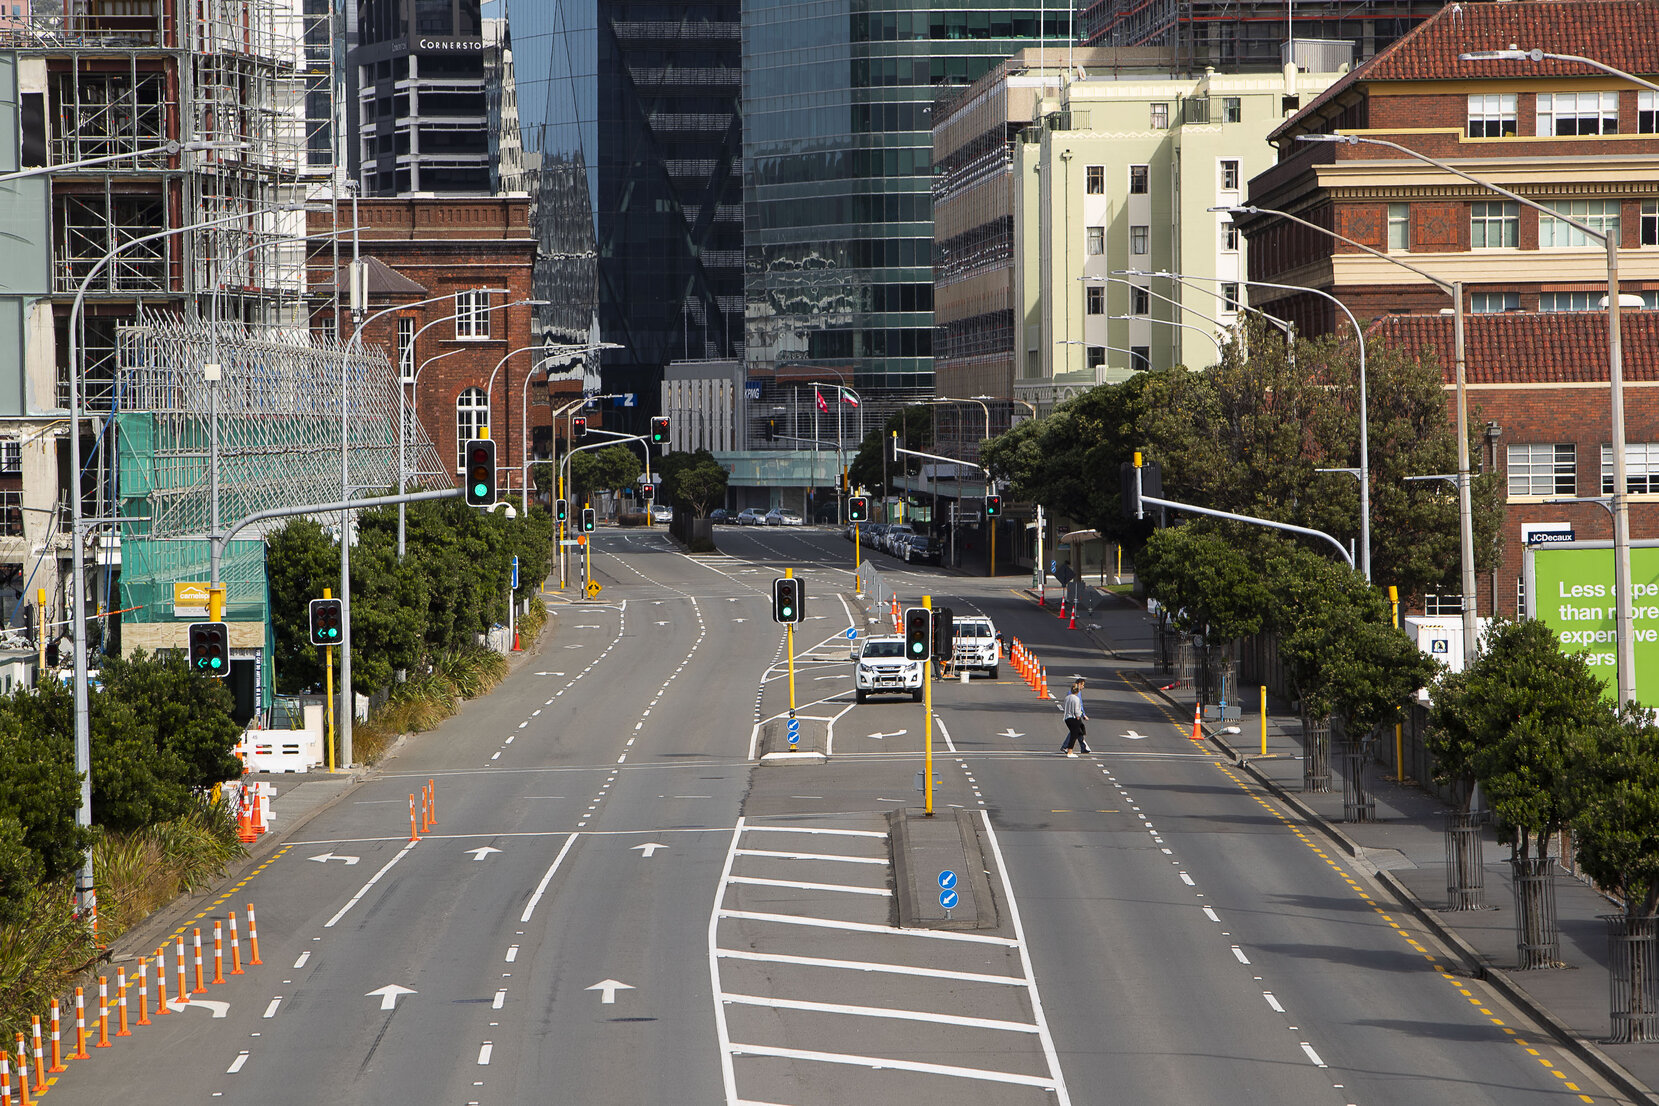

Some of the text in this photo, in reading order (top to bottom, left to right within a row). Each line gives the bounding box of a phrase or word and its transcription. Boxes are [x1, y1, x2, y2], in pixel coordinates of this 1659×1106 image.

[744, 388, 760, 399] KPMG
[1530, 533, 1573, 542] JCDecaux
[1559, 581, 1605, 598] Less
[1558, 604, 1603, 620] than
[1560, 626, 1658, 647] expenive
